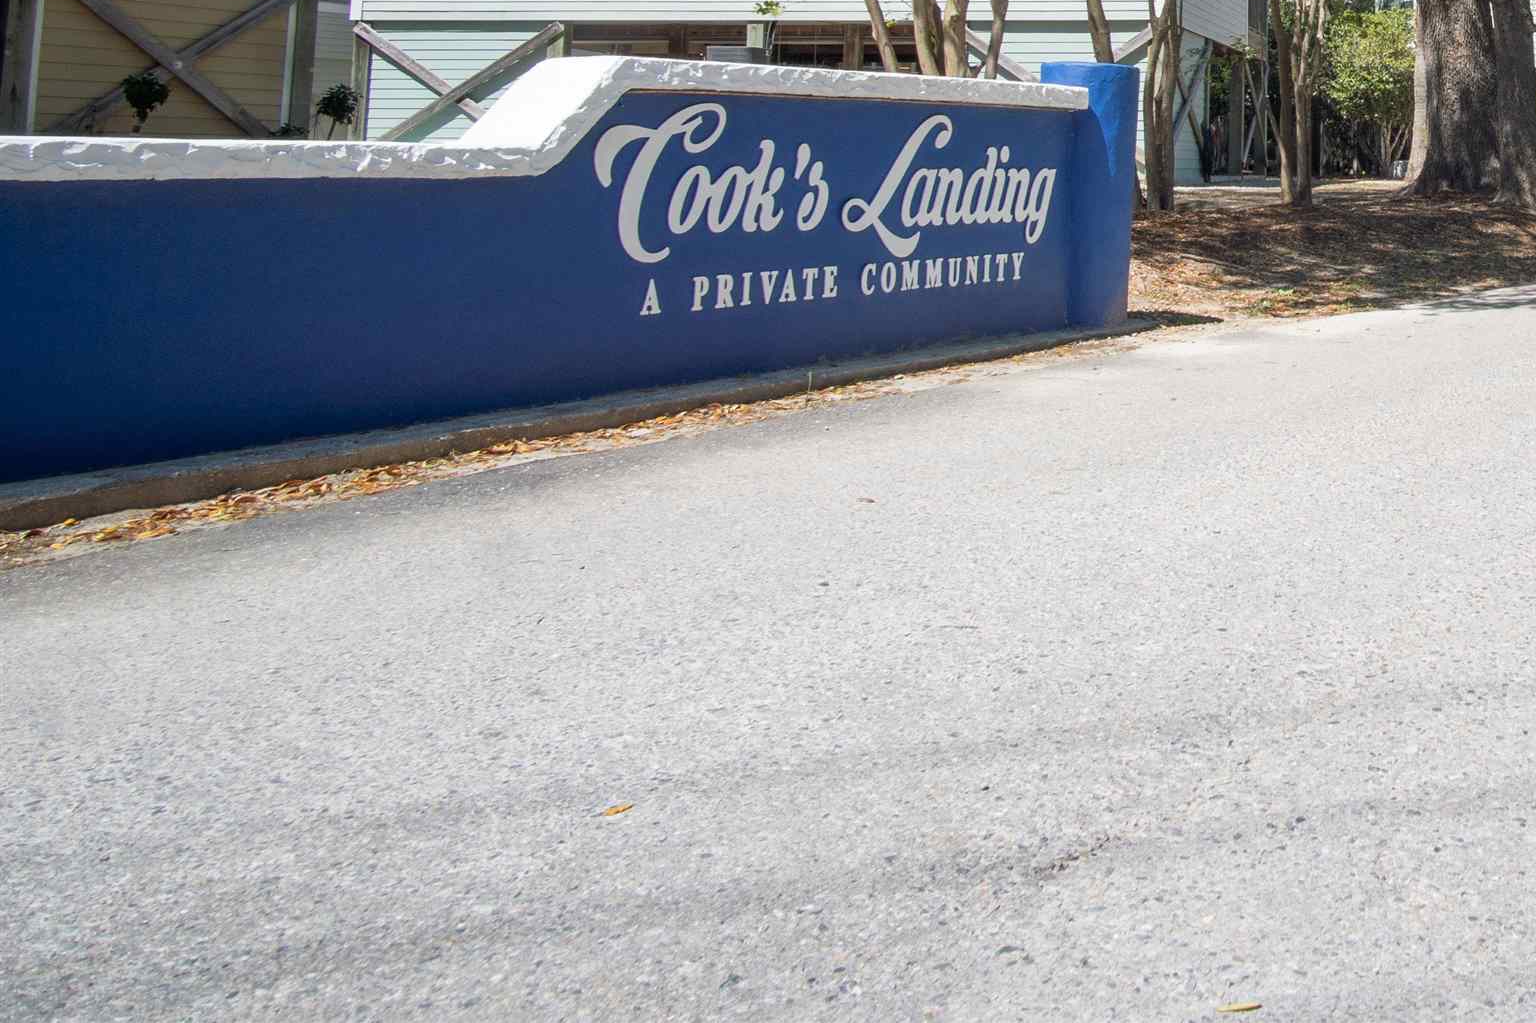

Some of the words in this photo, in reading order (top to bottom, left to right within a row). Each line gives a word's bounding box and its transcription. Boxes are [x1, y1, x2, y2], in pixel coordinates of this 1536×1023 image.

[593, 102, 829, 263] Cook's
[841, 114, 1057, 258] Landing
[639, 278, 662, 316] A
[690, 265, 839, 312] PRIVATE
[860, 251, 1026, 296] COMMUNITY
